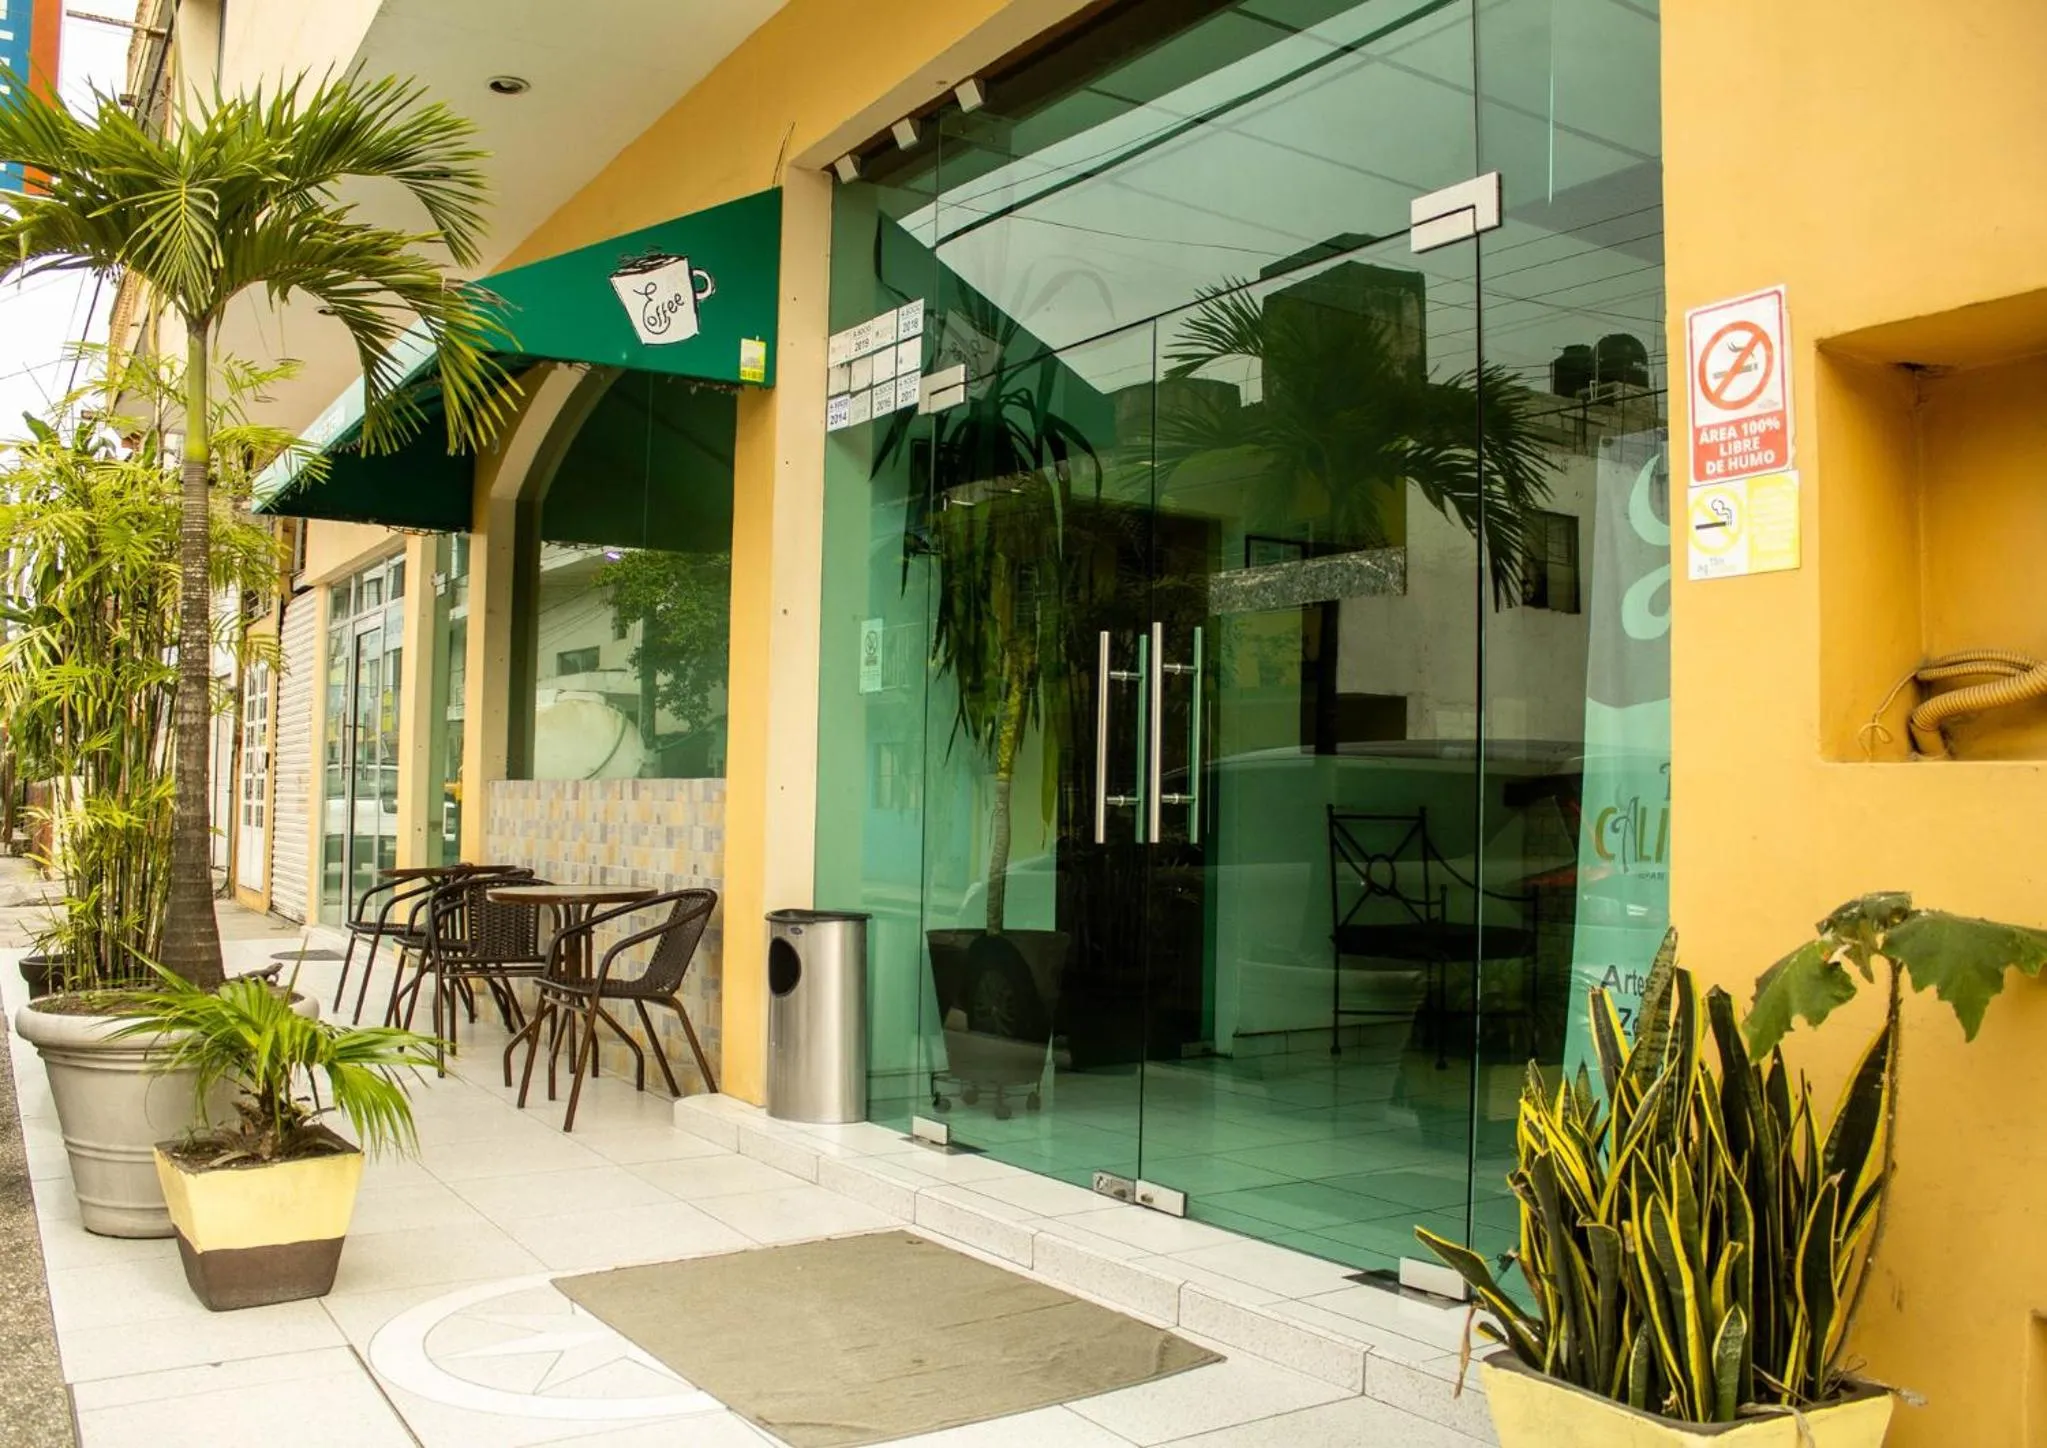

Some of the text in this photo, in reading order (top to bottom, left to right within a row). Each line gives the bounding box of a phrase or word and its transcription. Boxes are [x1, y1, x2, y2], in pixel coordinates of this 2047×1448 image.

[633, 282, 685, 335] Coffee
[830, 412, 847, 426] 2014
[1699, 416, 1781, 445] ÁREA 100%
[1719, 436, 1762, 458] LIBRE
[1705, 449, 1776, 476] DE HUMO
